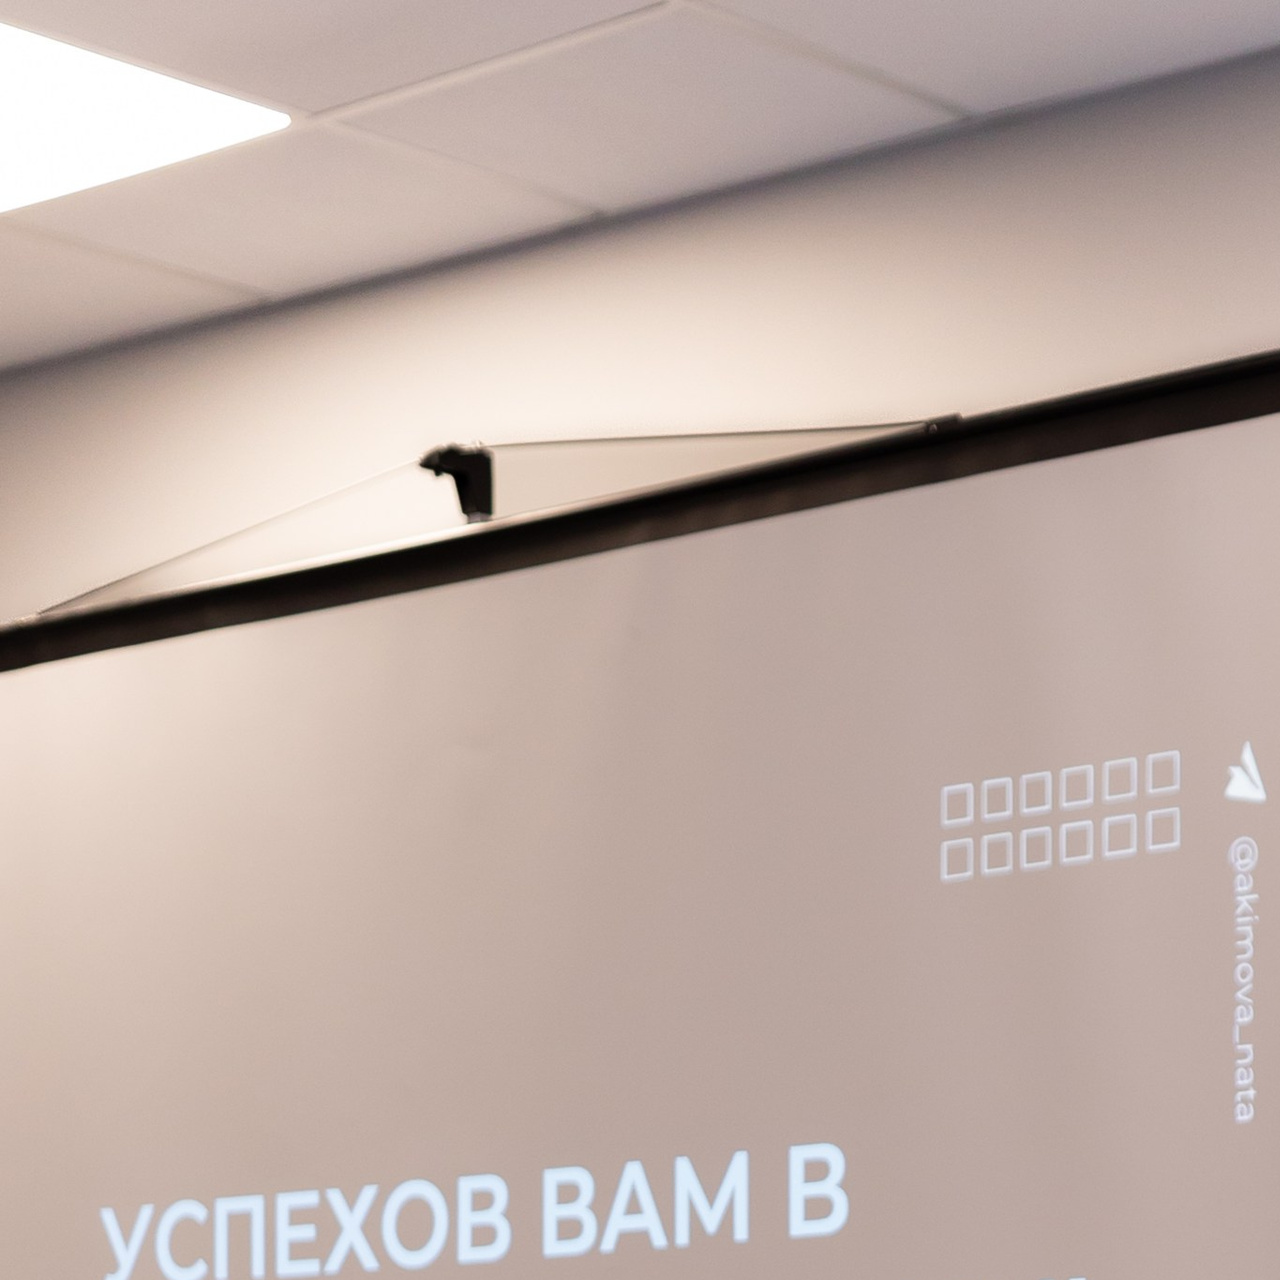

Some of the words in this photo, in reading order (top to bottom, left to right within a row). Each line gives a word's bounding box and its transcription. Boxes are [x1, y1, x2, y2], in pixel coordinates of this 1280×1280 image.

[1227, 835, 1260, 1124] @akimova_nata
[541, 1149, 750, 1259] ВАМ
[787, 1141, 850, 1239] В
